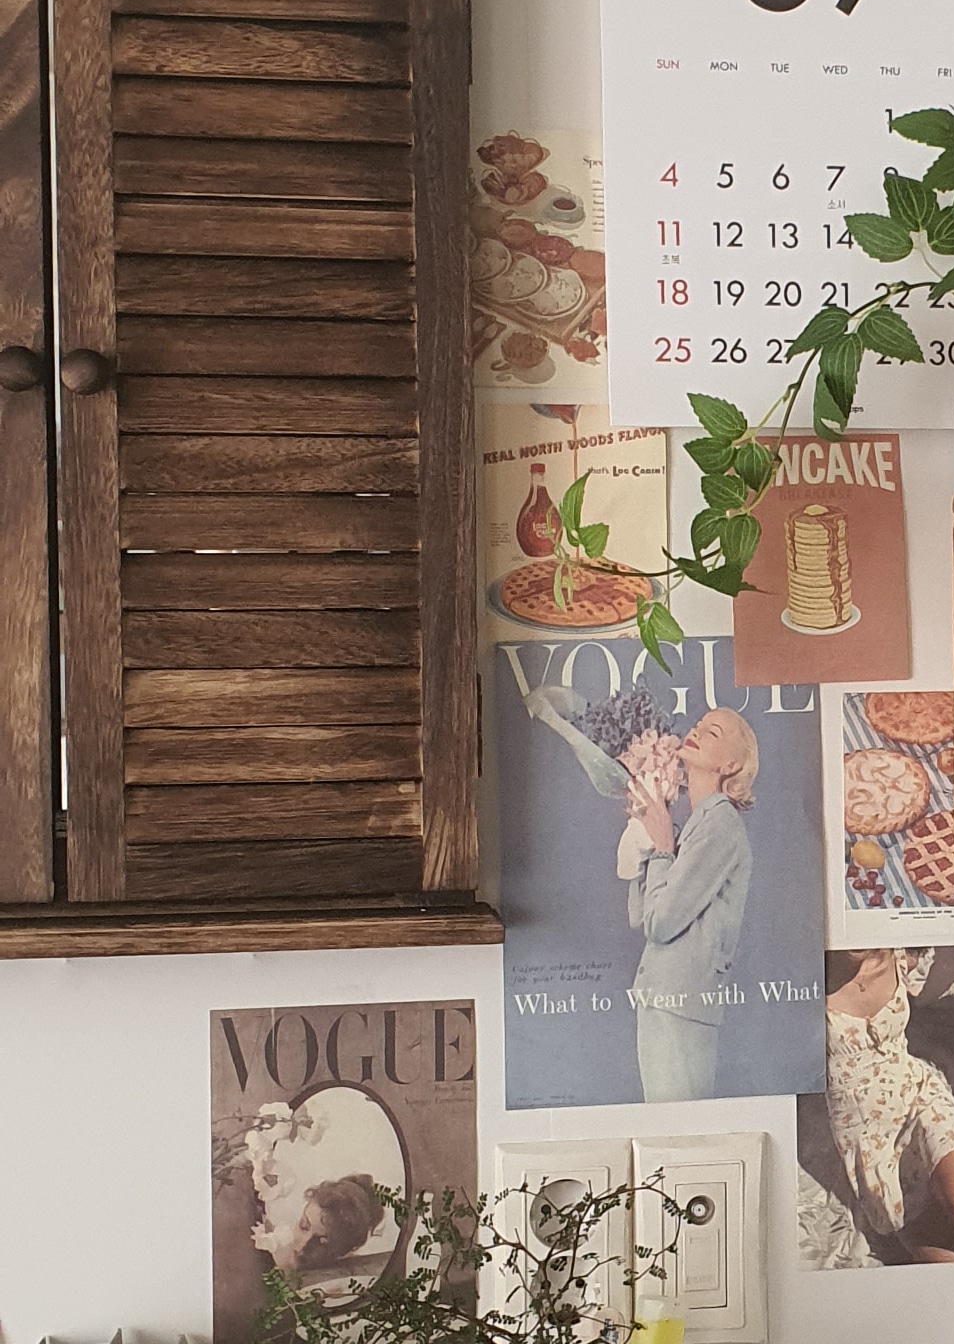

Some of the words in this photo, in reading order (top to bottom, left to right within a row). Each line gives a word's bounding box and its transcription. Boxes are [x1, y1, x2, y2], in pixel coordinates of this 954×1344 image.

[655, 58, 681, 70] SUN
[709, 61, 739, 72] MON
[769, 62, 791, 74] TUE
[821, 64, 849, 76] WED
[879, 66, 901, 77] THU
[936, 67, 953, 78] FRI
[659, 162, 679, 187] 4
[716, 163, 735, 189] 5
[771, 163, 790, 190] 6
[826, 165, 846, 191] 7
[657, 220, 681, 246] 11
[712, 221, 744, 248] 12
[767, 222, 799, 249] 13
[822, 224, 854, 249] 14
[656, 279, 690, 306] 18
[712, 280, 745, 307] 19
[764, 281, 802, 307] 20
[820, 282, 849, 308] 21
[654, 337, 692, 364] 25
[710, 338, 748, 364] 26
[482, 449, 516, 465] REAL
[518, 441, 563, 460] NORTH
[566, 432, 614, 451] WOODS
[763, 442, 896, 492] NCAKE
[512, 992, 578, 1016] What
[591, 992, 612, 1012] to
[626, 986, 688, 1009] Wear
[700, 982, 746, 1007] with
[758, 979, 822, 1004] What
[220, 1006, 476, 1094] VOGUE
